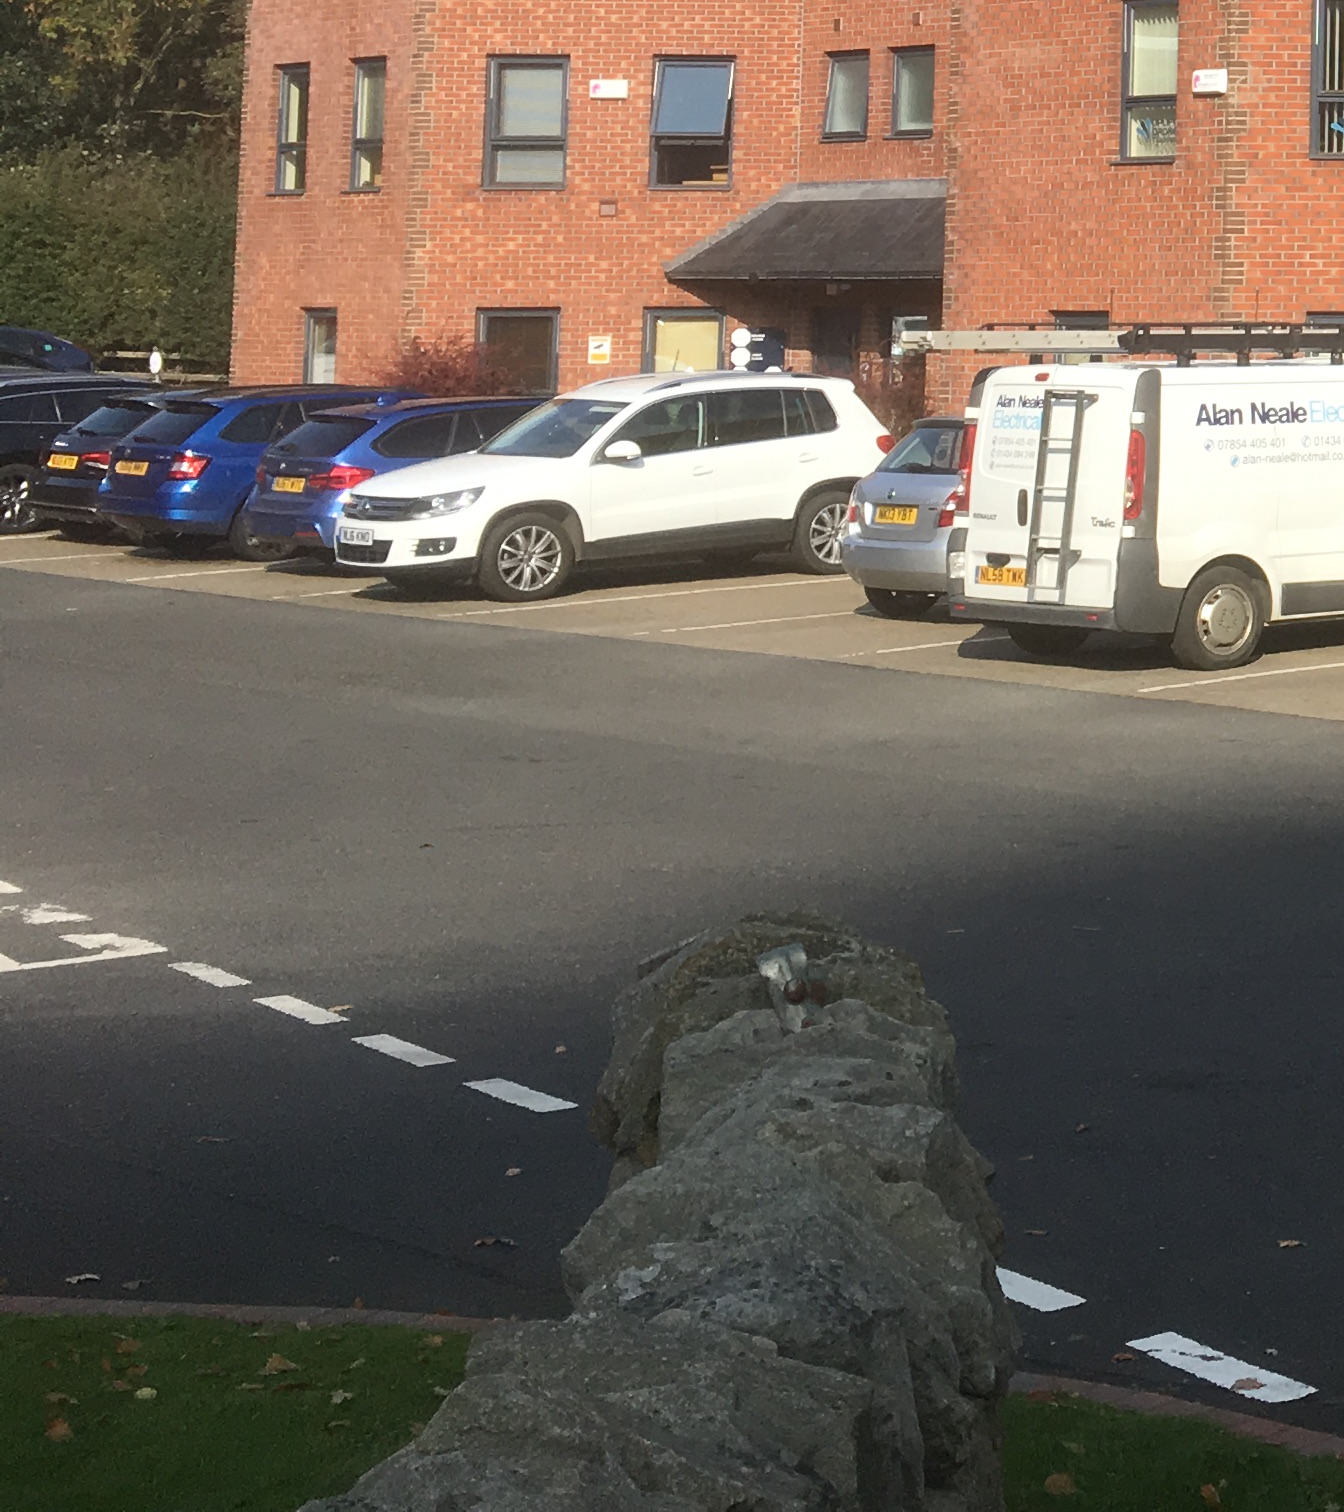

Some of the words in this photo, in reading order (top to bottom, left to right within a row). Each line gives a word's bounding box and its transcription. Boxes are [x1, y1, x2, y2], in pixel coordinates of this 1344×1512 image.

[996, 394, 1016, 408] Alan
[1018, 394, 1044, 409] Neale
[1195, 403, 1243, 427] Alan
[1250, 401, 1308, 425] Neale
[1217, 439, 1247, 450] 07854
[1250, 438, 1268, 449] 405
[1270, 437, 1286, 448] 401
[1313, 435, 1341, 446] 01434
